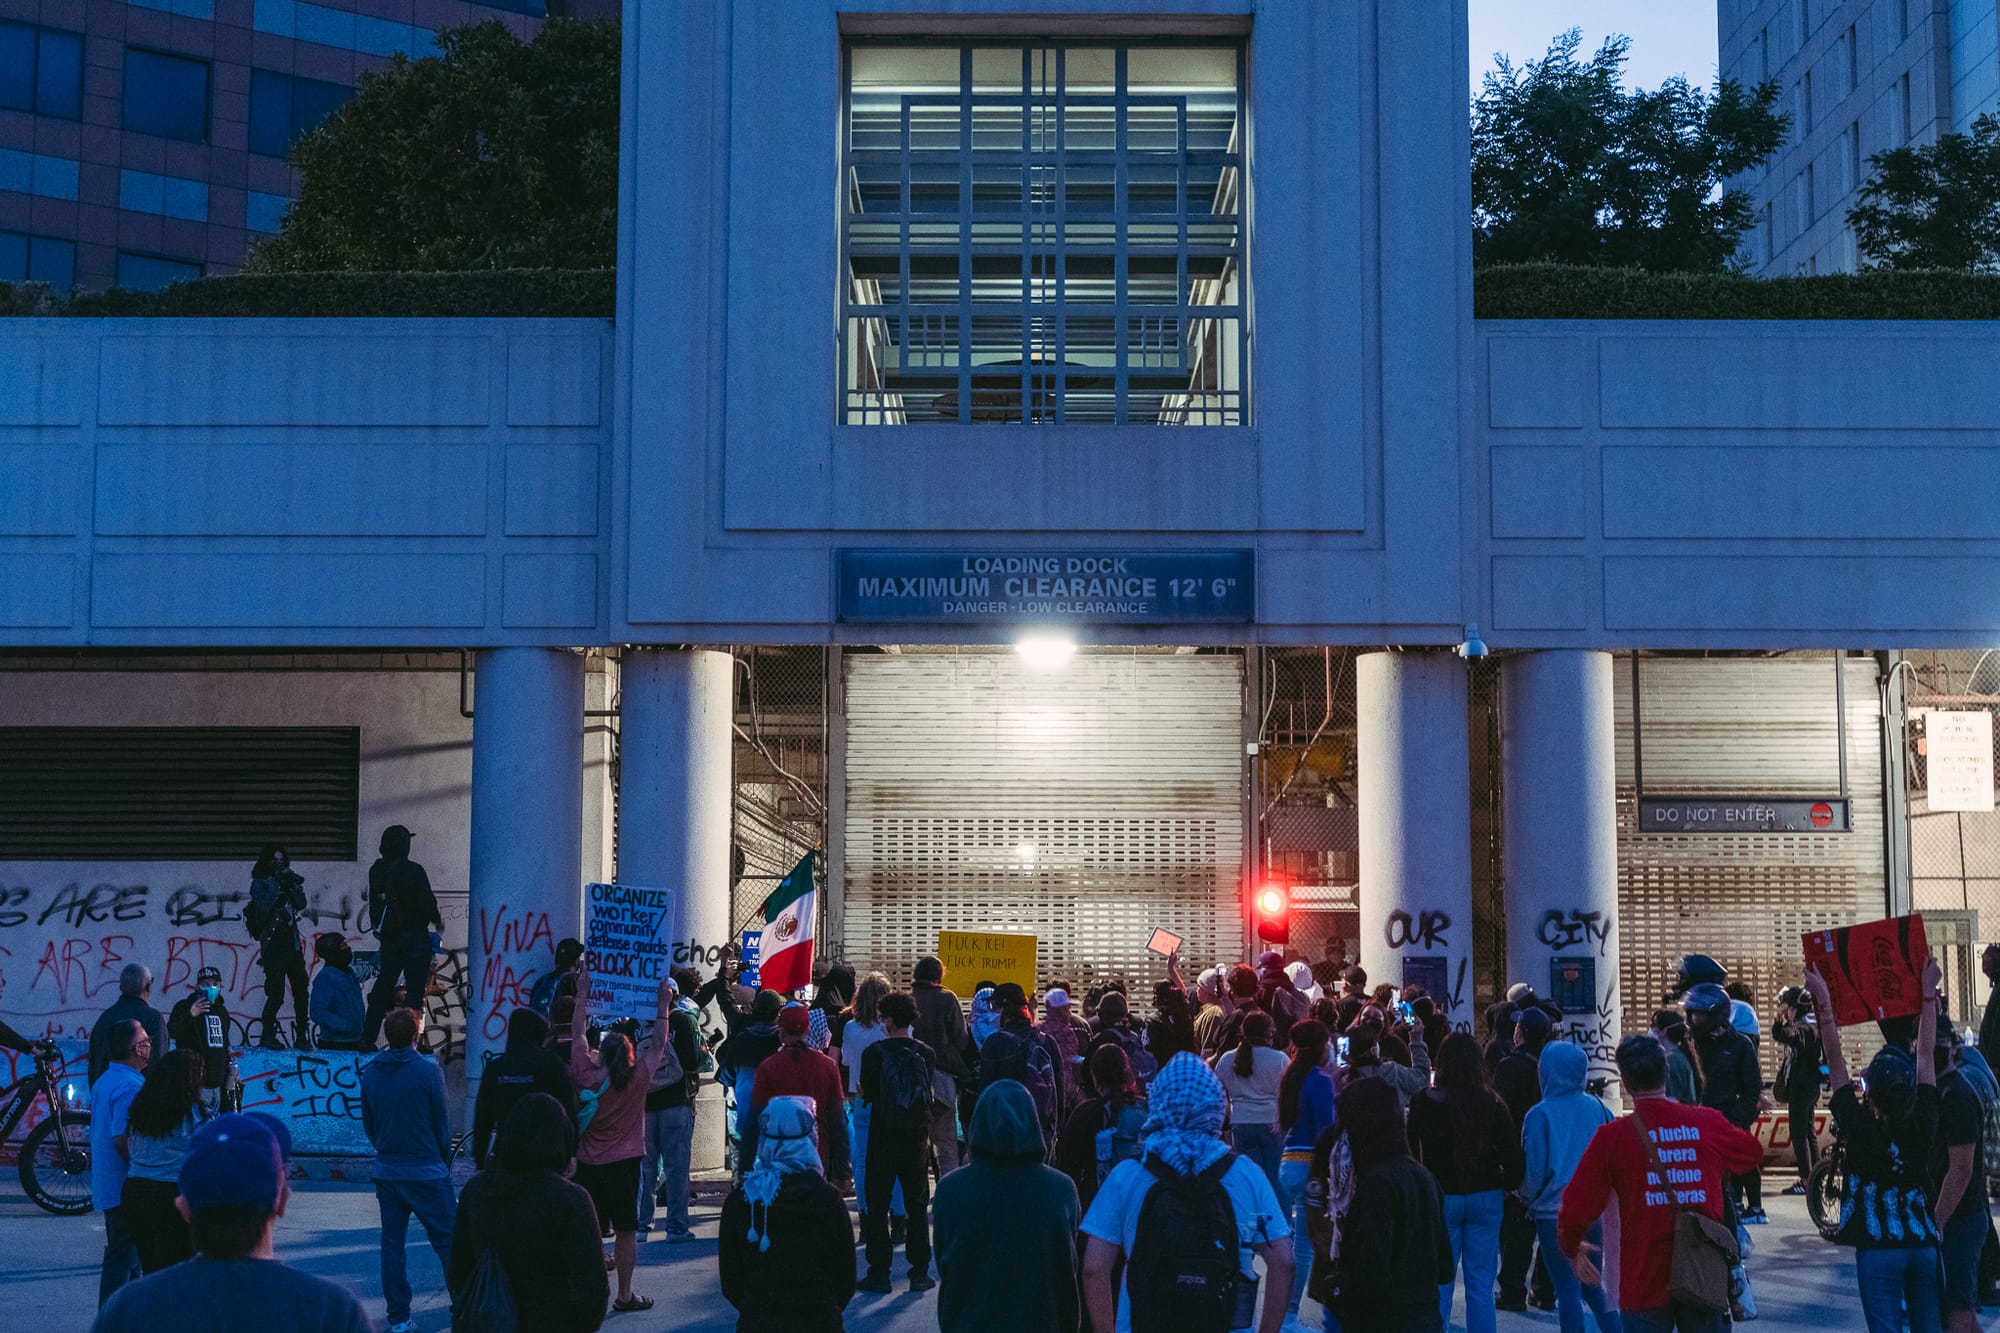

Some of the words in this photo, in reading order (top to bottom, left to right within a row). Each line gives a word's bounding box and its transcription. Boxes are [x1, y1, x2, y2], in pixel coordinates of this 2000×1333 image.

[962, 558, 1060, 574] LOADING
[1066, 558, 1127, 574] DOCK
[858, 577, 990, 598] MAXIMUM
[1004, 577, 1156, 598] CLEARANCE
[1168, 578, 1203, 598] 12'
[1211, 578, 1237, 598] 6"
[943, 601, 1007, 614] DANGER
[1018, 601, 1052, 614] LOW
[1057, 601, 1147, 614] CLEARANCE
[1655, 807, 1678, 822] DO
[1686, 807, 1717, 822] NOT
[1725, 807, 1776, 822] ENTER
[37, 882, 148, 928] ARE
[591, 884, 667, 908] ORGANIZE
[589, 918, 657, 940] community
[1385, 909, 1451, 949] OUR
[1537, 909, 1610, 956] CITY
[587, 931, 631, 951] defense
[632, 937, 668, 959] guards
[948, 934, 980, 951] FUCK
[985, 937, 1005, 951] ICE!
[32, 935, 134, 1005] ARE
[585, 950, 634, 977] BLOCK
[638, 956, 664, 980] ICE
[947, 955, 976, 968] FUCK
[1565, 1019, 1612, 1044] FUCK
[1583, 1046, 1616, 1062] ICE
[280, 1055, 368, 1089] FUCK
[292, 1091, 363, 1120] ICE
[1658, 1125, 1701, 1142] lucha
[1657, 1147, 1697, 1163] brera
[1666, 1168, 1702, 1183] tiene
